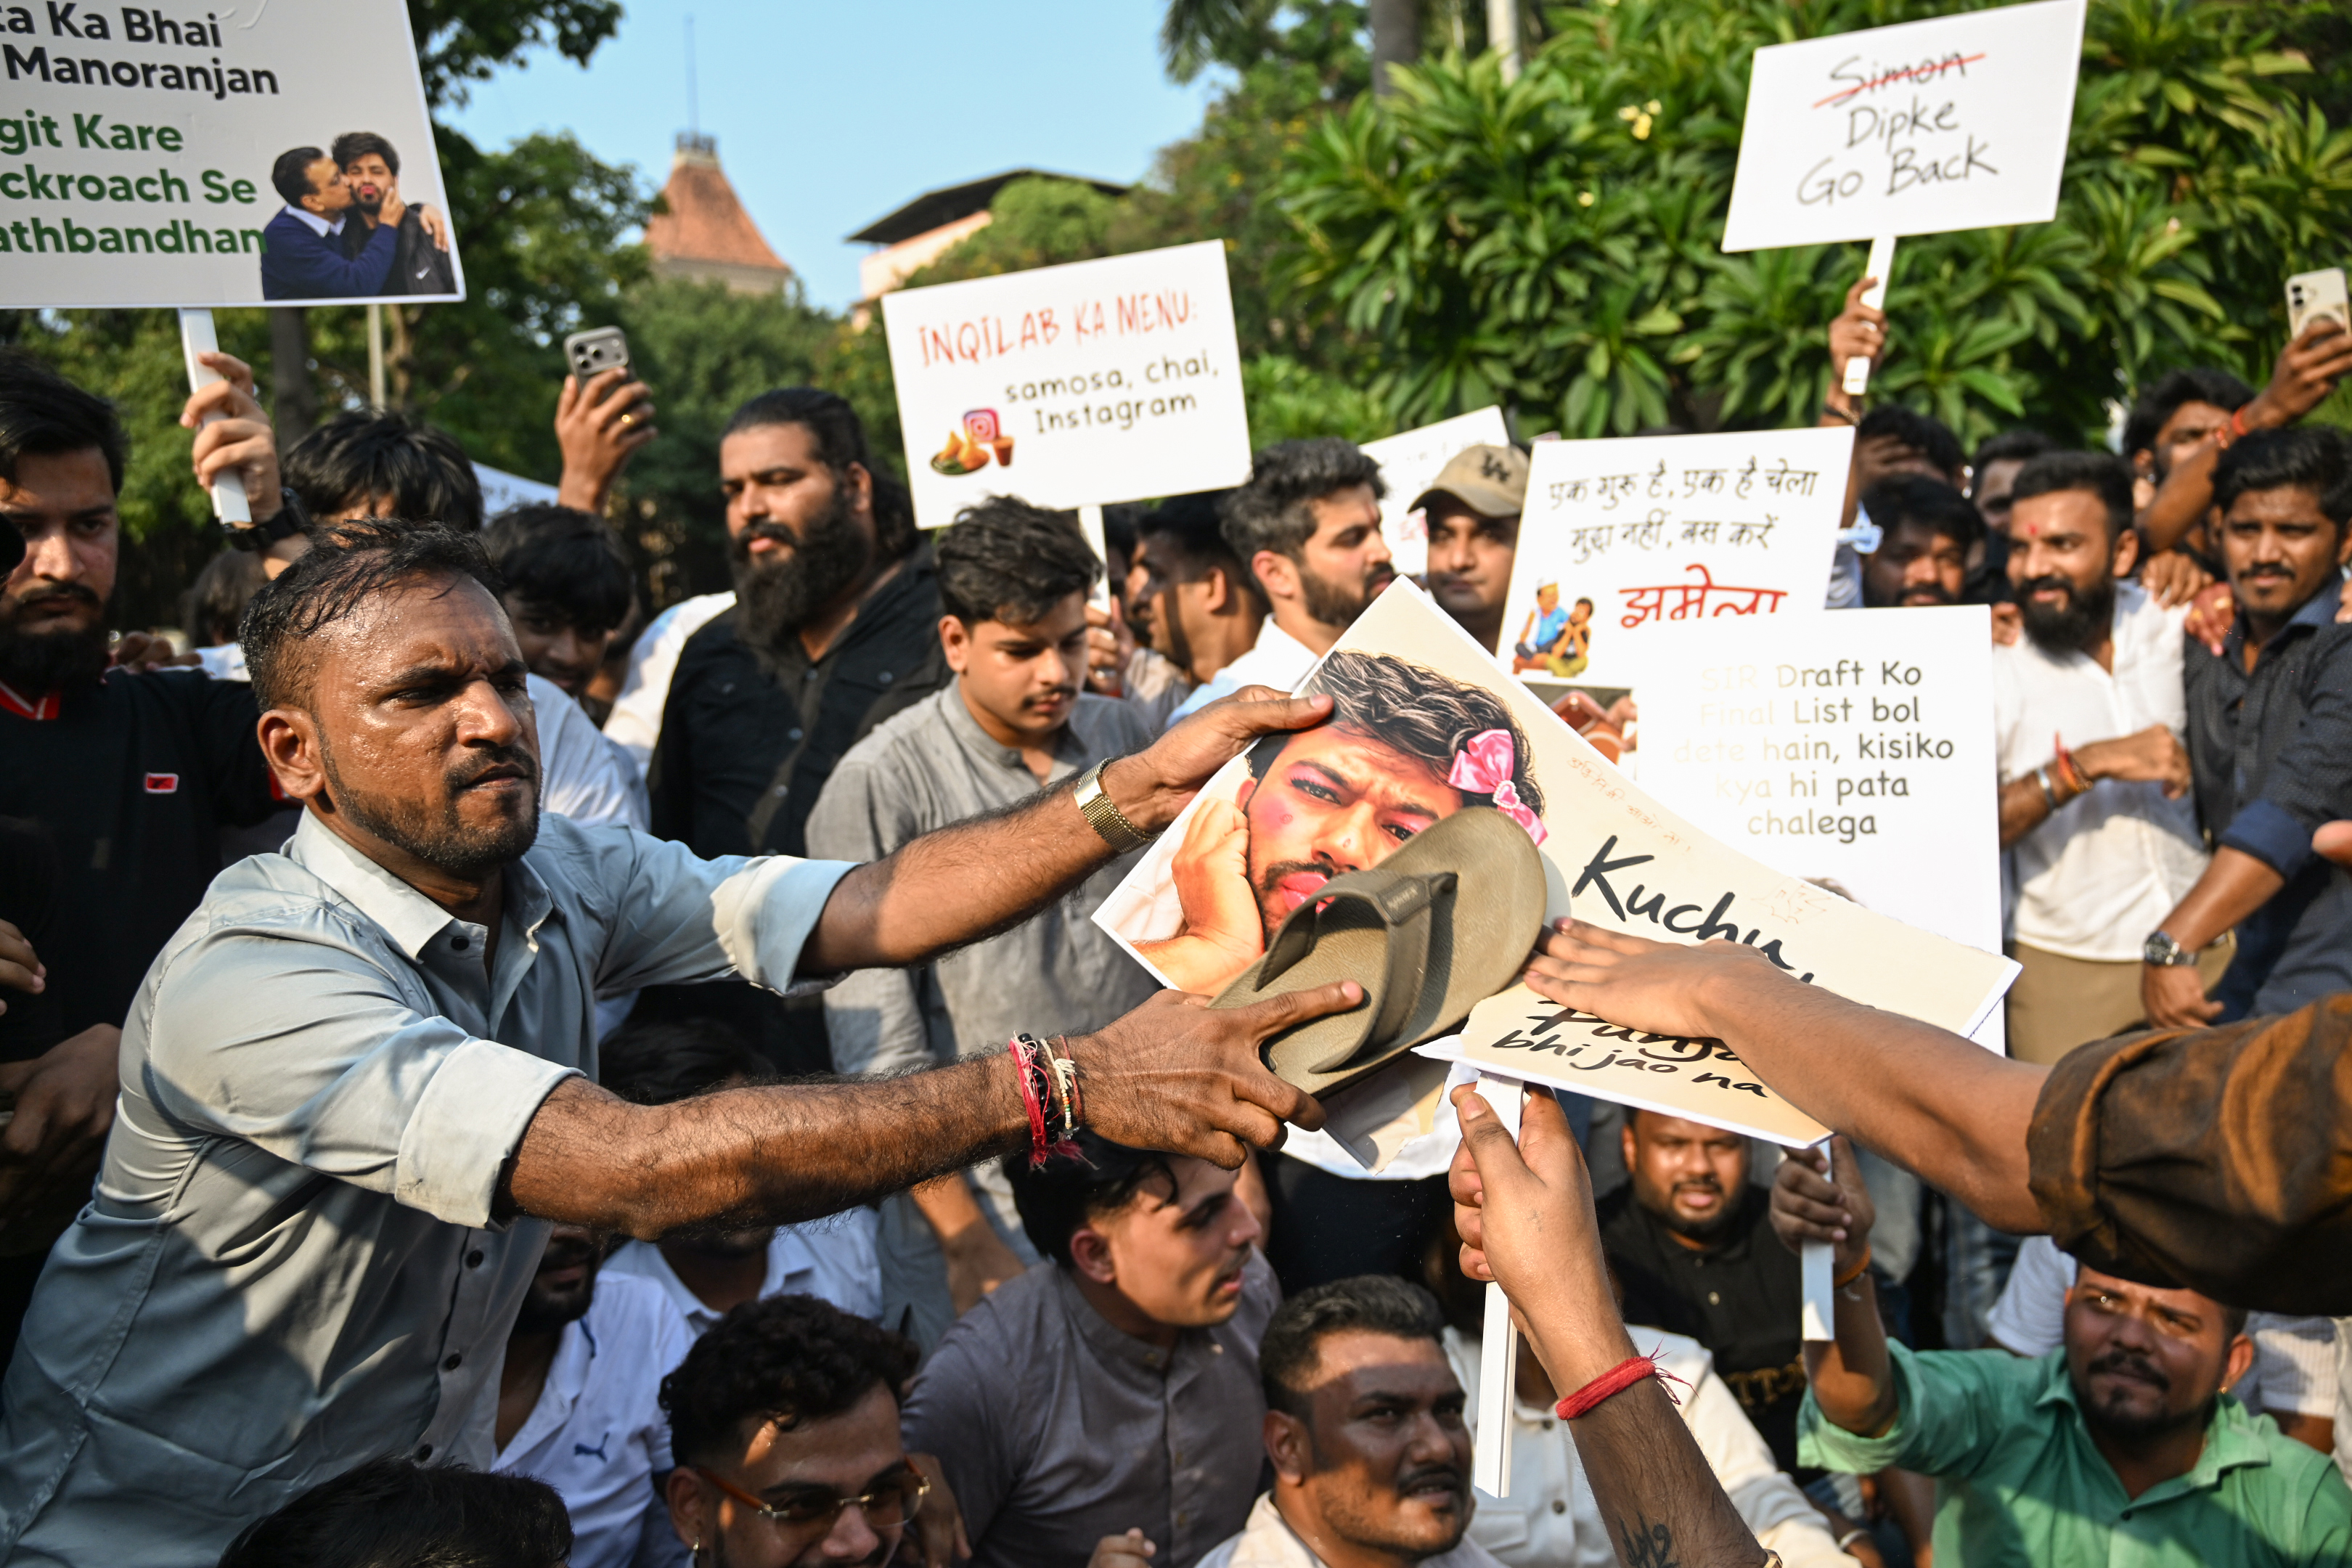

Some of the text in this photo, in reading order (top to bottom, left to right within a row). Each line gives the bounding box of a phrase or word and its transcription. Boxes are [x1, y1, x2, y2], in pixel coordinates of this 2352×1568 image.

[46, 1, 111, 40] Ka
[122, 7, 223, 48] Bhai
[2, 44, 279, 100] Manoranjan
[1830, 52, 1966, 107] Simon
[73, 113, 183, 152] Kare
[1847, 96, 1959, 152] Dipke
[0, 164, 258, 204] ckroach Se
[1797, 135, 1998, 205] Go Back
[918, 290, 1198, 367] INQILAB KA MENU:
[1005, 350, 1219, 404] samosa, chai,
[1035, 392, 1196, 434] Instagram
[1550, 478, 1591, 510] एक
[1683, 468, 1728, 499] एक
[1735, 455, 1757, 499] है
[1765, 457, 1819, 496] चेला
[1619, 563, 1788, 628] झमेला
[1701, 660, 1922, 692] SIR Draft Ko
[1700, 695, 1920, 727] Final List bol
[1673, 732, 1954, 764] dete hain, kisiko
[1715, 770, 1909, 806] kya hi pata
[1747, 808, 1878, 844] chalega
[1491, 1029, 1768, 1098] bhi jao na
